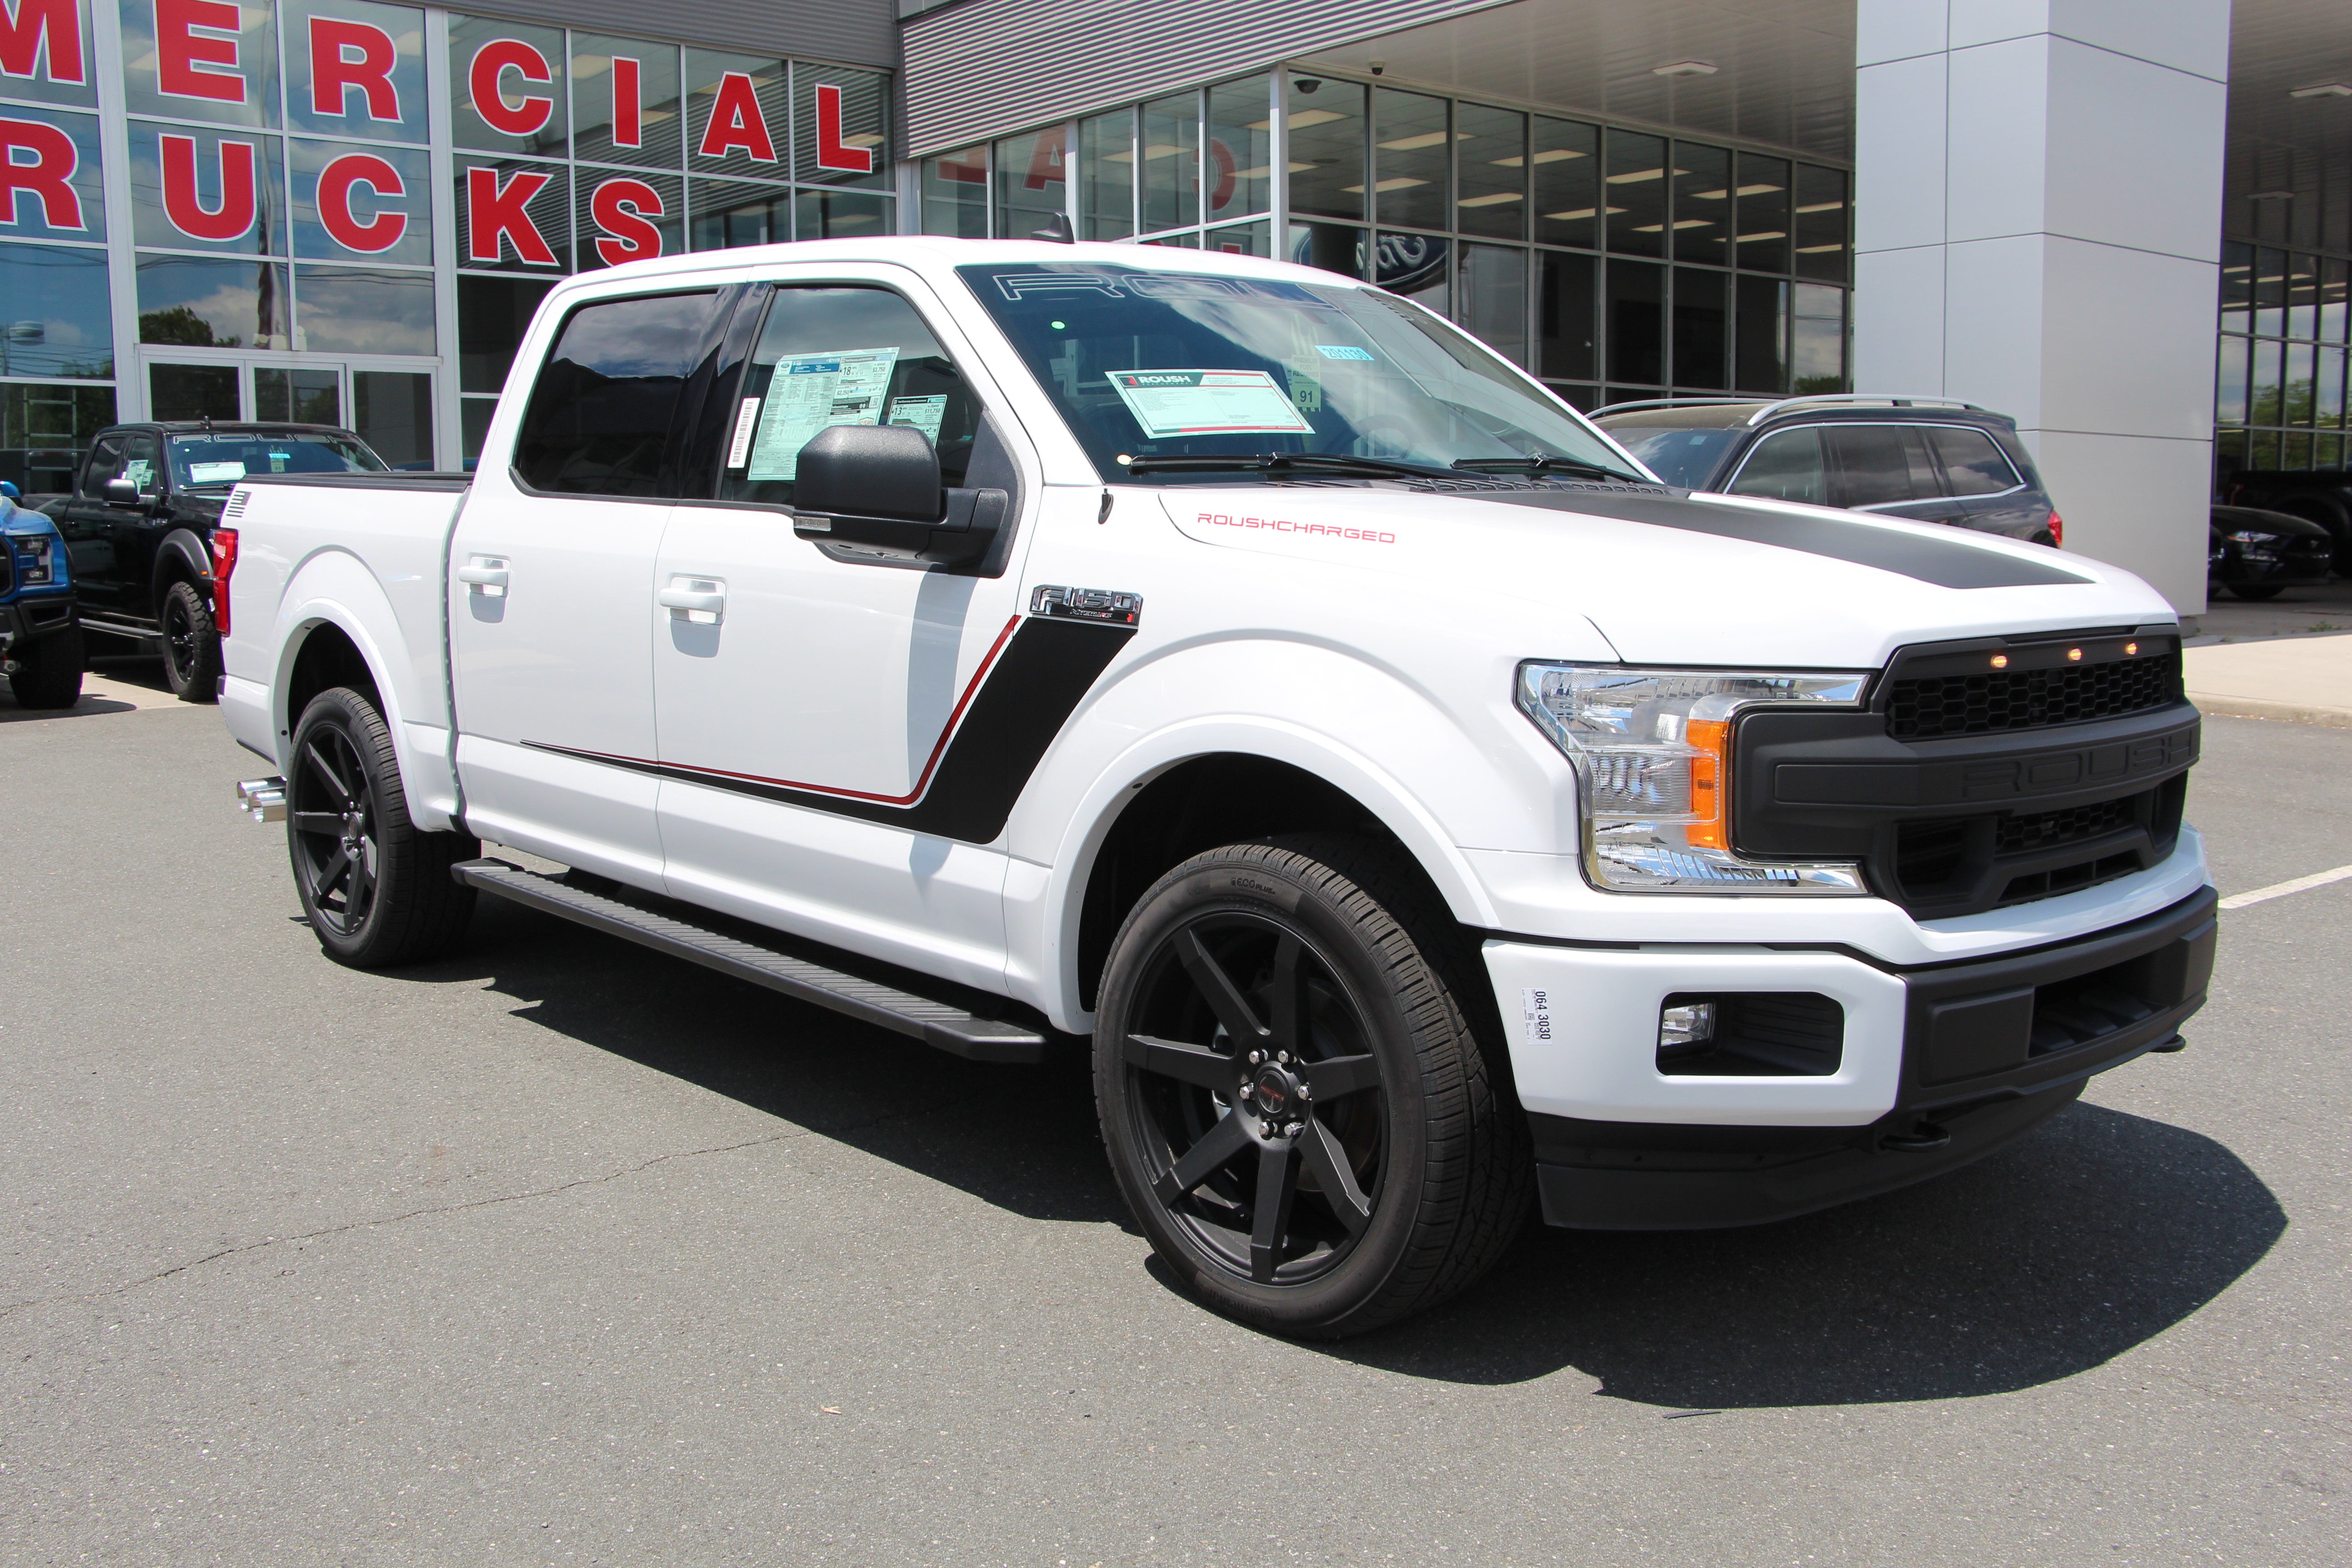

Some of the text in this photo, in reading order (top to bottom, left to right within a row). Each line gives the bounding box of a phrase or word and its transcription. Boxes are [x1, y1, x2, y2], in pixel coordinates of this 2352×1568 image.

[0, 116, 665, 267] RUCKS
[1322, 348, 1370, 360] 201130
[843, 367, 851, 376] 18
[1300, 390, 1313, 402] 91
[894, 407, 902, 415] 13
[174, 434, 355, 445] ROUSH
[1197, 513, 1396, 544] ROUSHCHARGED
[1962, 728, 2192, 798] ROUSH
[1535, 991, 1548, 1010] 064
[1538, 1014, 1551, 1039] 3030
